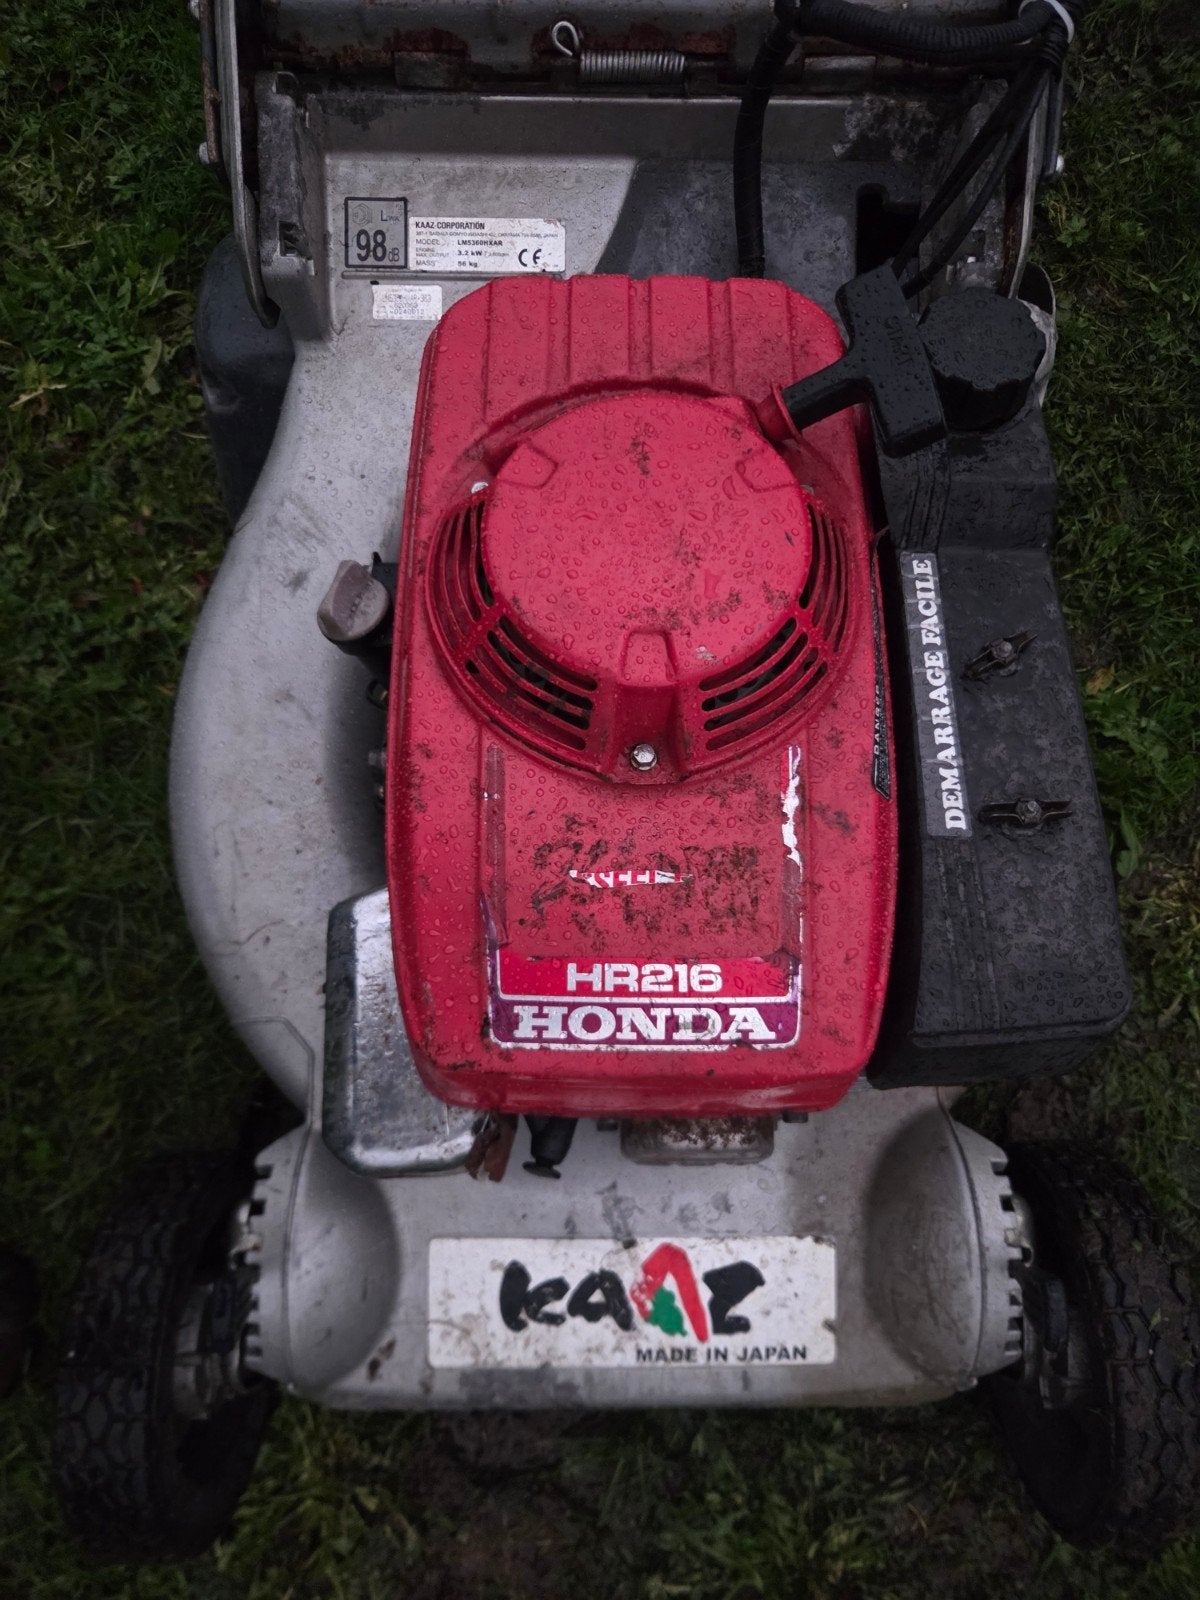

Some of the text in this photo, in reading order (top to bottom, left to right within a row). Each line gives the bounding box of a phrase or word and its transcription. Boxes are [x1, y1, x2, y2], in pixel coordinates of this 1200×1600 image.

[415, 221, 485, 230] KAAZ CORPORATION
[356, 229, 400, 262] 98 dB
[518, 248, 542, 267] CE
[912, 559, 967, 830] DEMARRAGE FACILE
[566, 962, 722, 992] HR216
[513, 1005, 777, 1041] HONDA
[635, 1344, 807, 1364] MADE IN JAPAN
